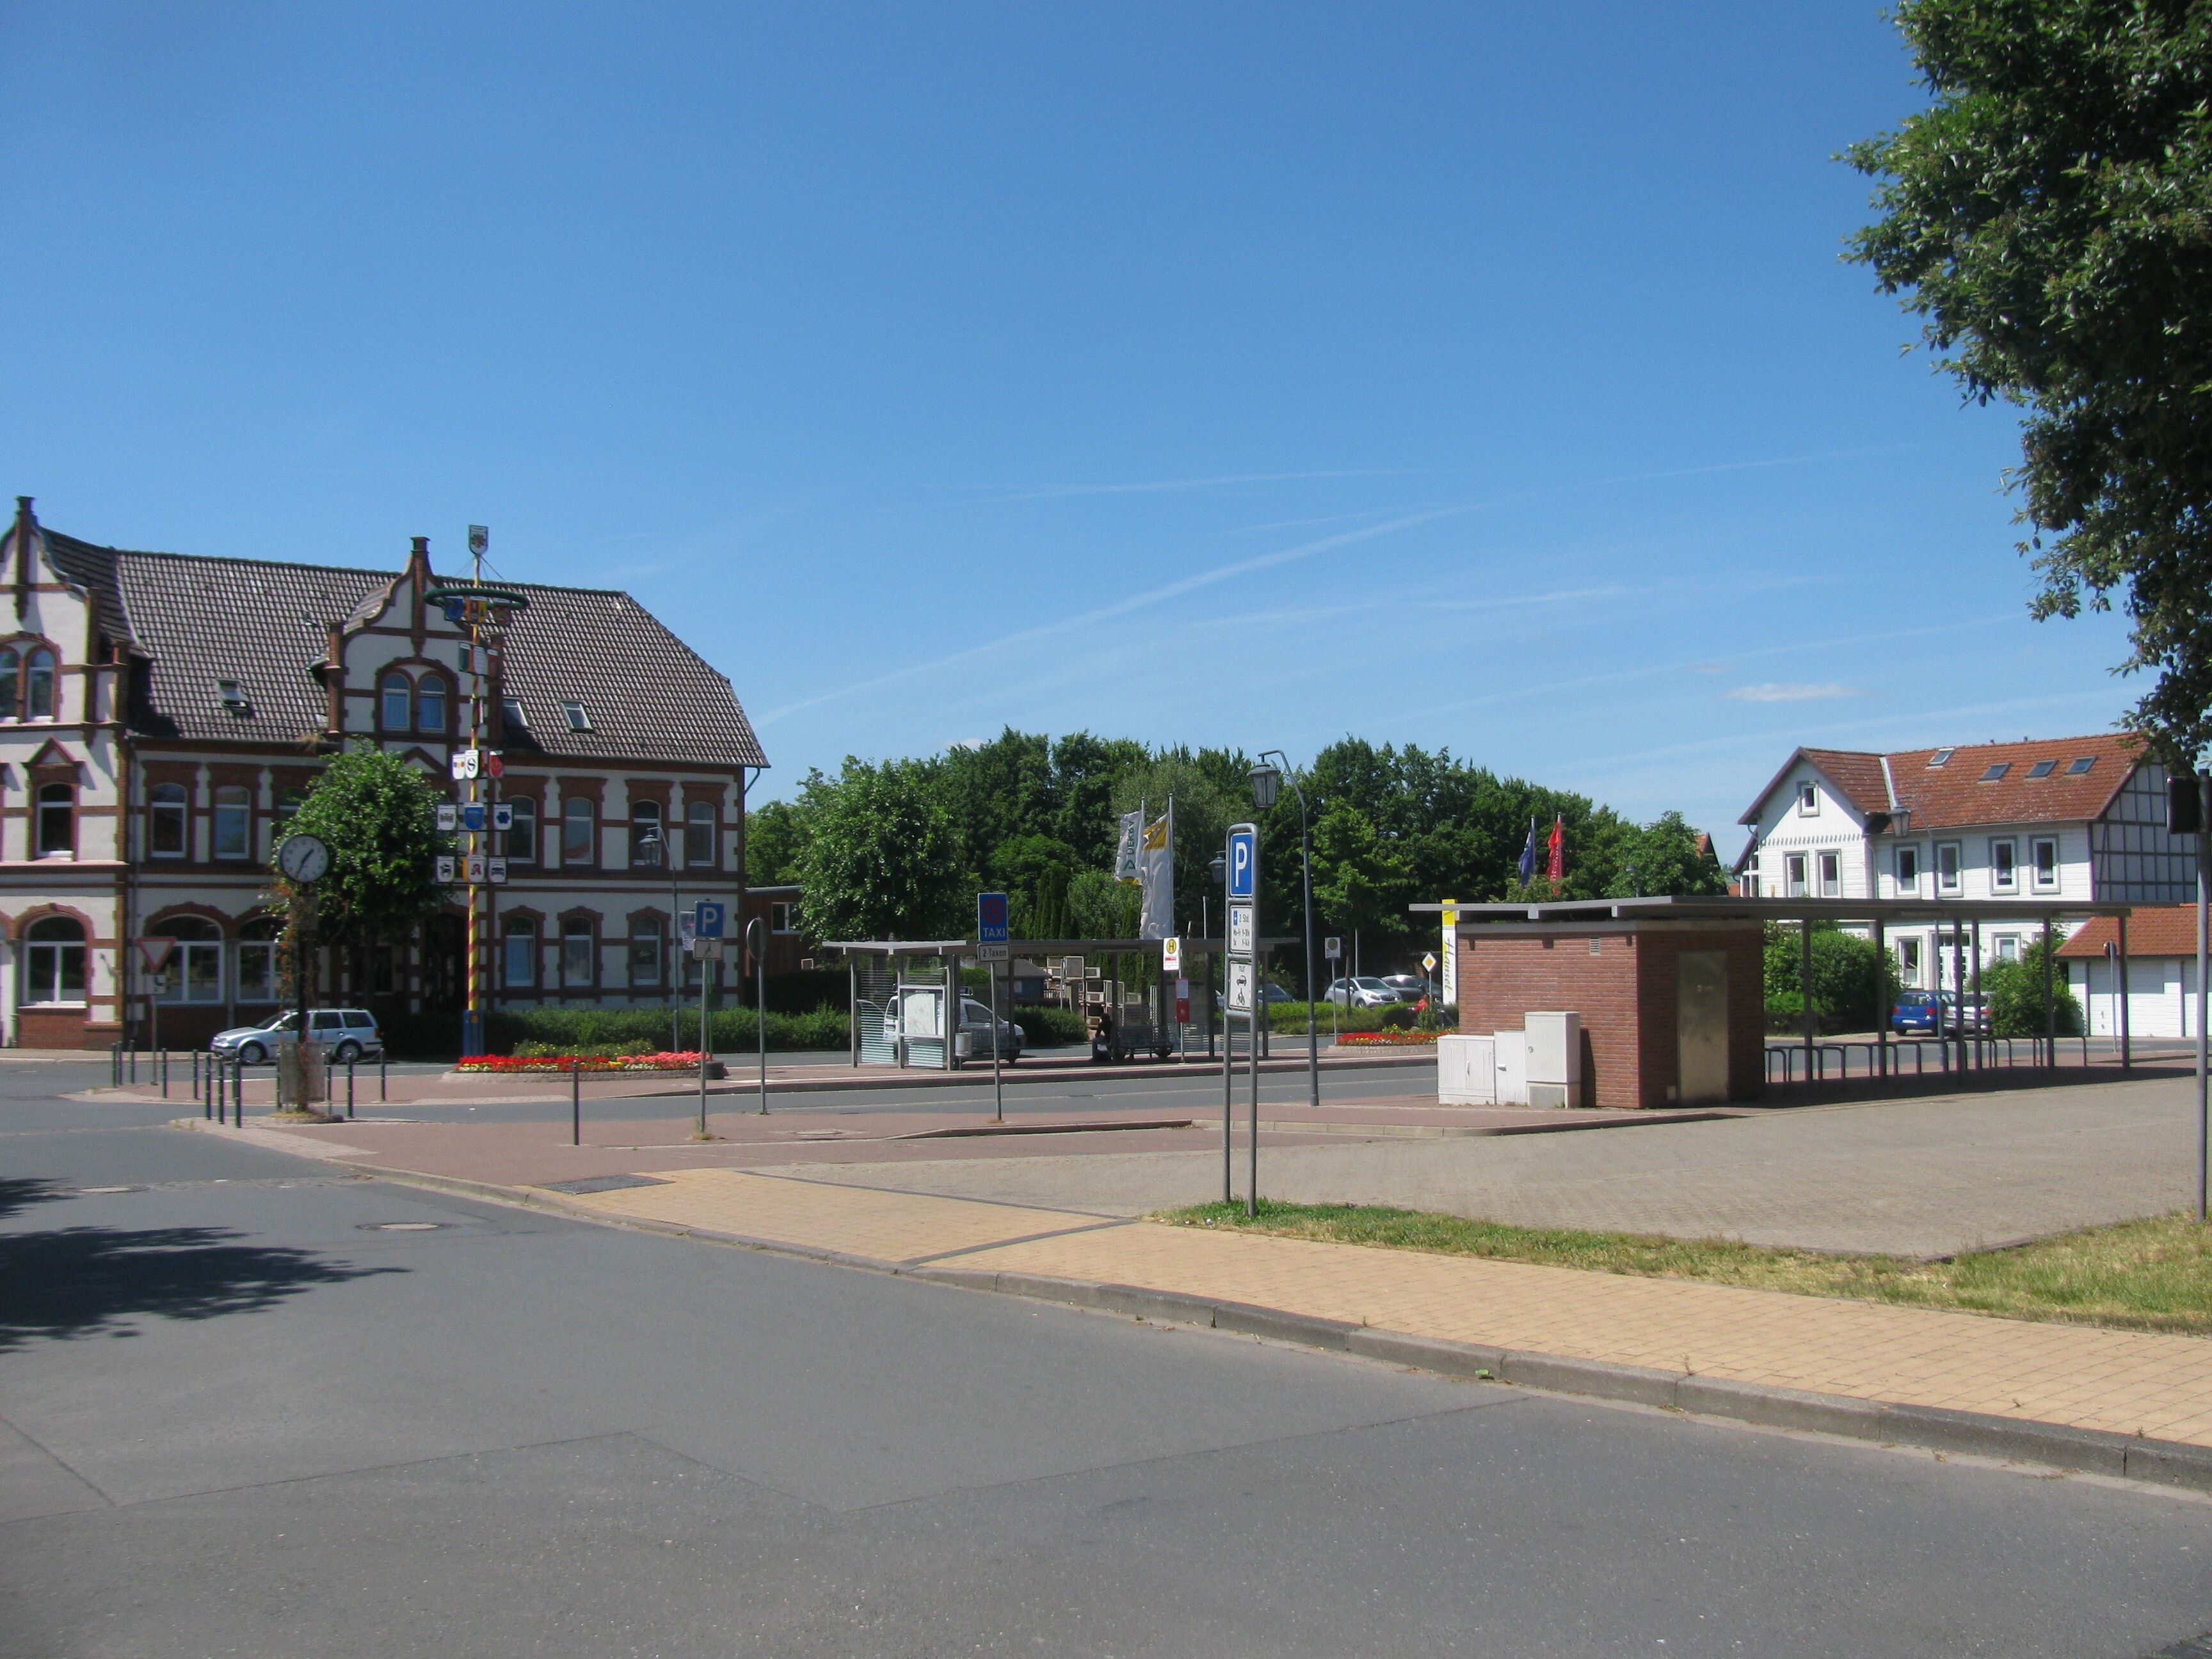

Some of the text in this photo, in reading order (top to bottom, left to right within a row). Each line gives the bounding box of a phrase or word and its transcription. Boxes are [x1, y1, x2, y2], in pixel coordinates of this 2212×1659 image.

[1236, 842, 1247, 887] P
[702, 907, 717, 933] P
[983, 927, 1005, 938] TAXI
[1169, 942, 1174, 951] H
[983, 948, 1006, 957] 2 Taxen
